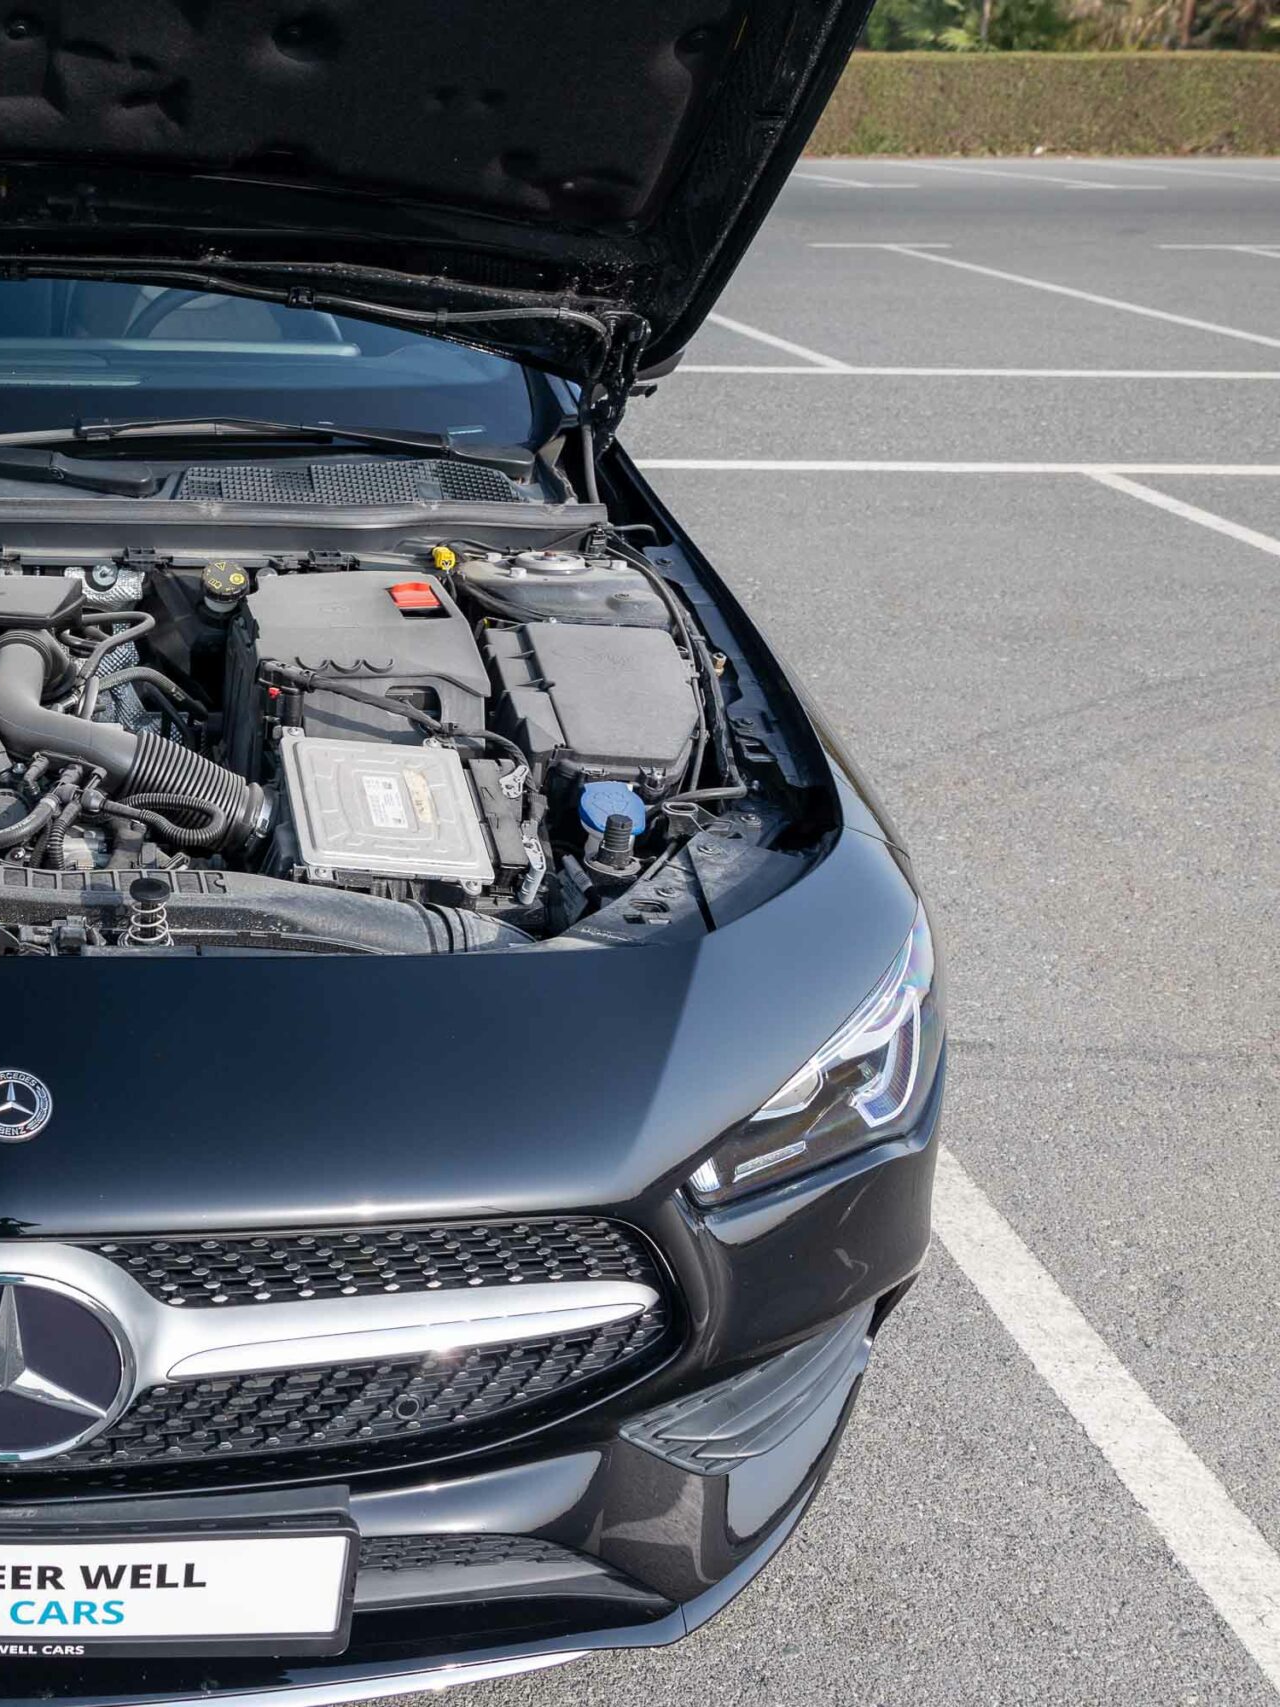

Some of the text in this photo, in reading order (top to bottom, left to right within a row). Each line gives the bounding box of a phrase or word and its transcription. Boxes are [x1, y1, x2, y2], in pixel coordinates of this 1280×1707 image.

[80, 1562, 207, 1590] WELL
[9, 1600, 125, 1625] CARS
[42, 1645, 85, 1655] CARS
